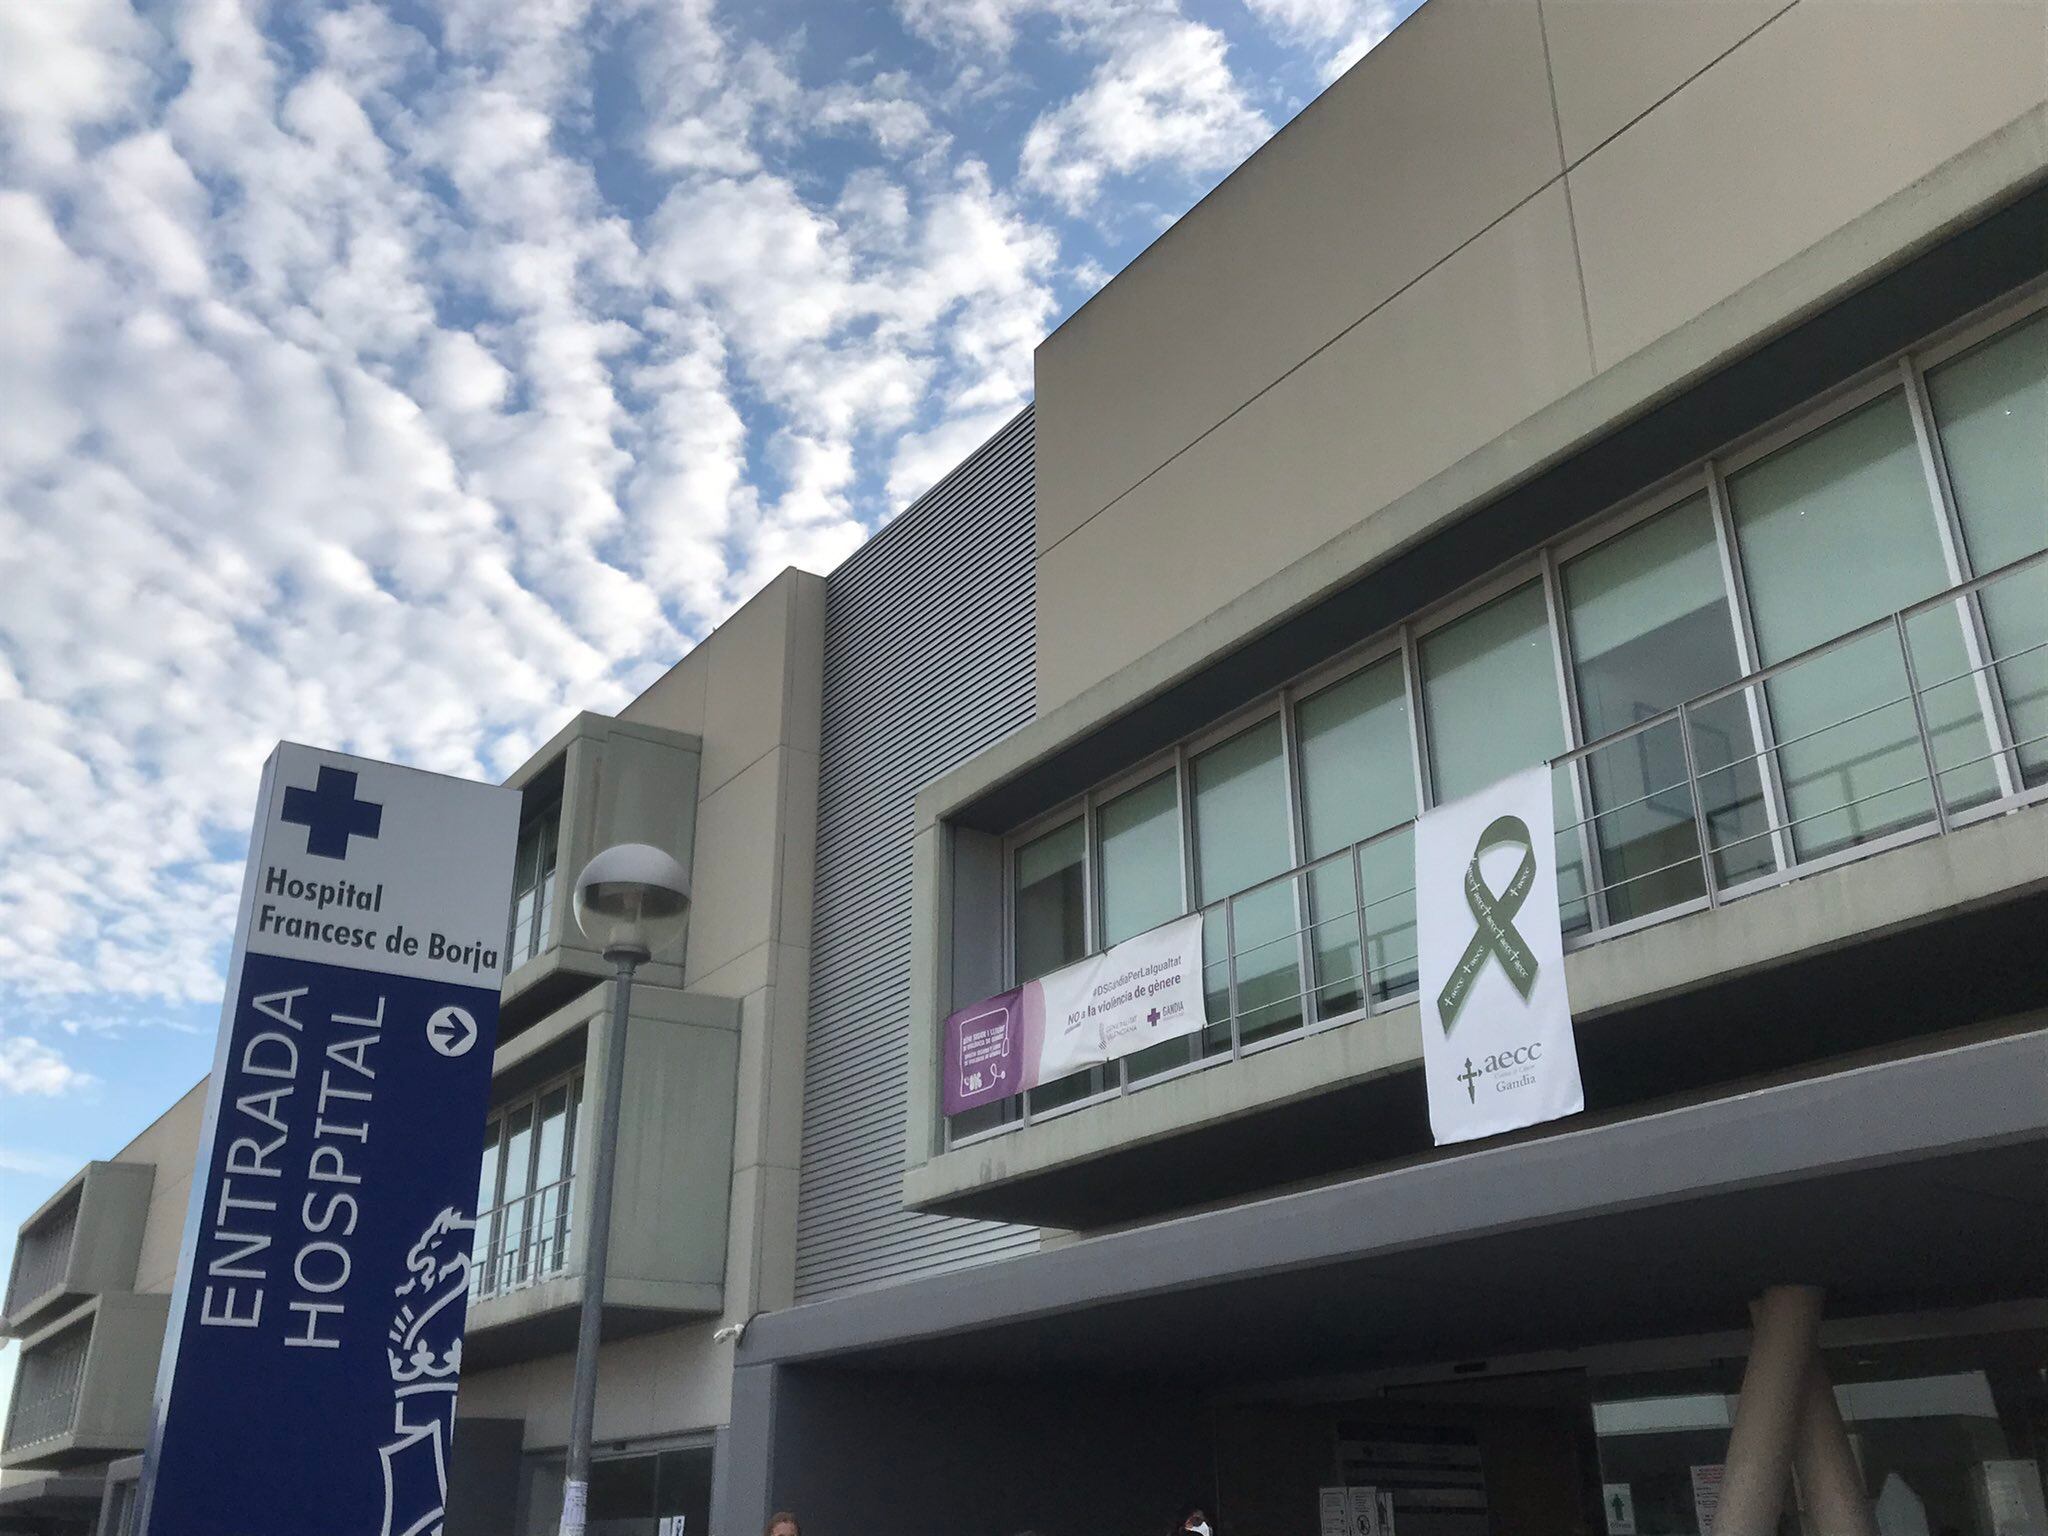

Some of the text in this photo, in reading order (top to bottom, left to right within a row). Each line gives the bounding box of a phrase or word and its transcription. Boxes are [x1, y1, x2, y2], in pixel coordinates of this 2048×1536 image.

[264, 866, 383, 912] Hospital
[258, 905, 498, 973] Francesc de Borja
[1067, 1011, 1080, 1026] NO
[1087, 1005, 1097, 1018] la
[1097, 990, 1133, 1014] violència
[1134, 985, 1146, 999] de
[1147, 974, 1181, 997] gènere
[1484, 1042, 1542, 1073] aecc
[1495, 1074, 1537, 1093] Gandia
[200, 985, 310, 1328] ENTRADA
[284, 996, 386, 1349] HOSPITAL
